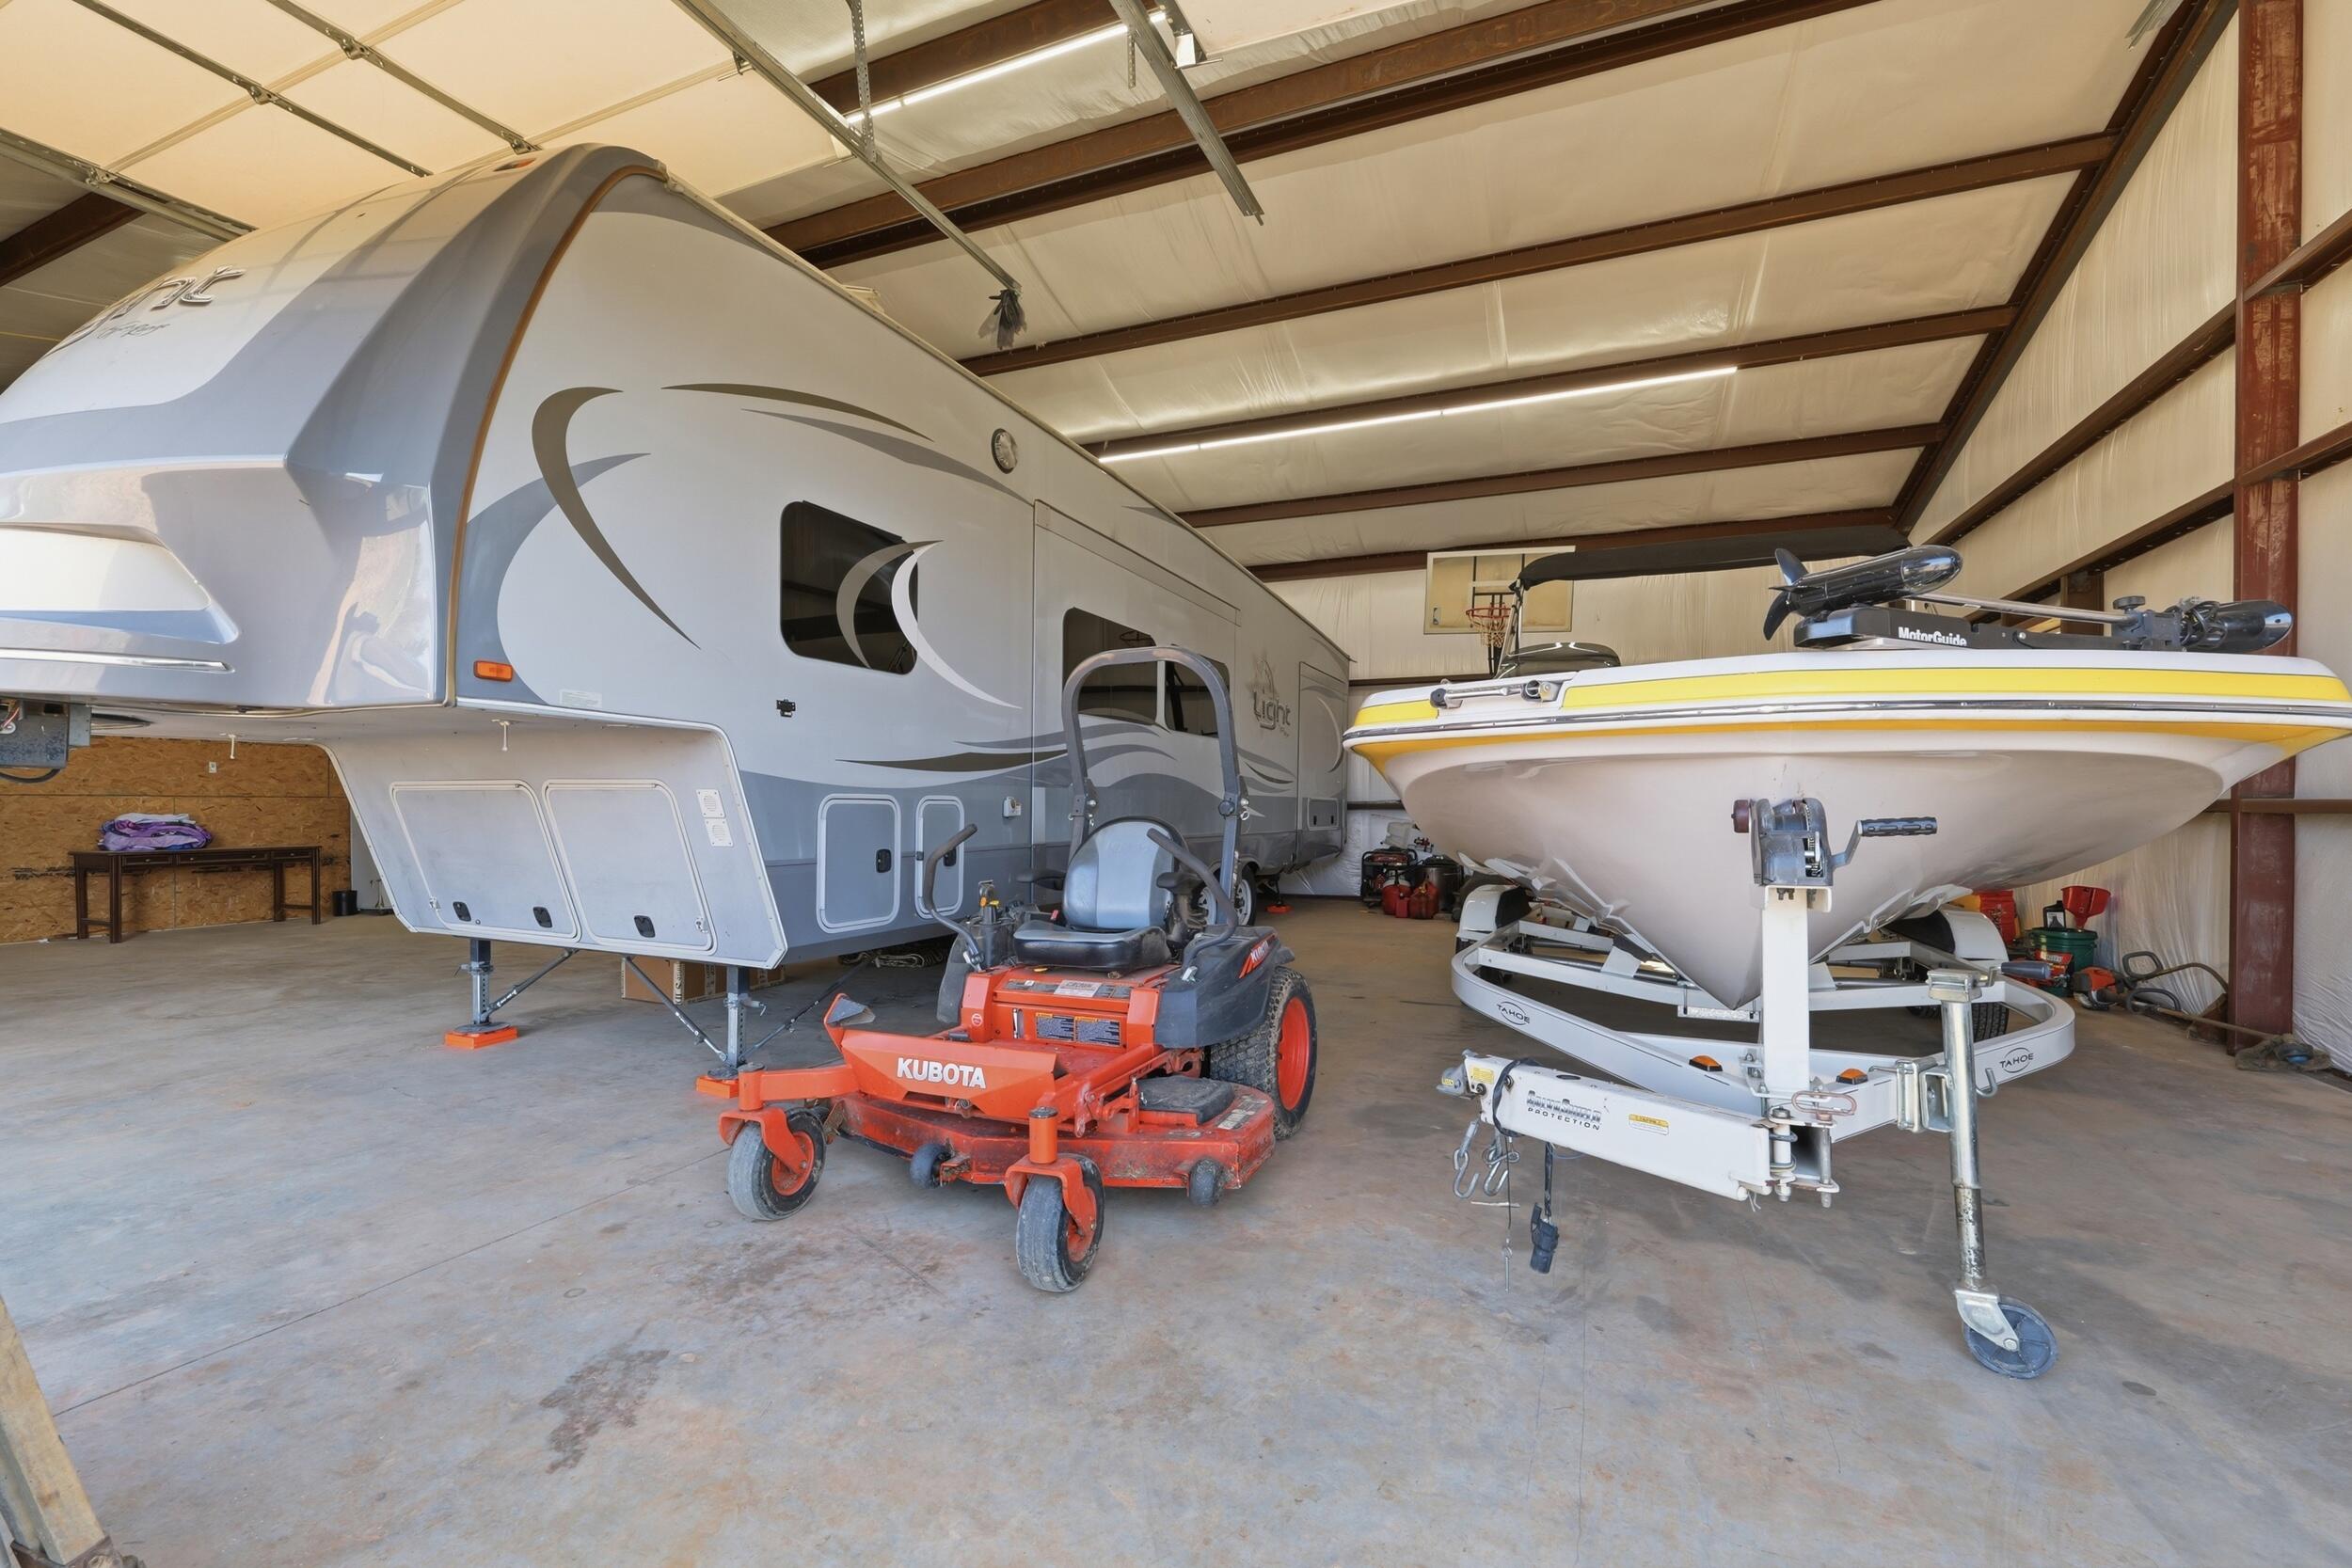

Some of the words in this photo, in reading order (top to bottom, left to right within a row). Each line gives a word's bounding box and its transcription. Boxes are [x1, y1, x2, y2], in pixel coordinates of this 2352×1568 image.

[1898, 626, 1967, 647] MotorGuide
[1496, 1003, 1531, 1024] TAHOE
[1998, 1053, 2034, 1069] TAHOE
[897, 1057, 986, 1089] KUBOTA
[1527, 1107, 1600, 1131] PROTECTION
